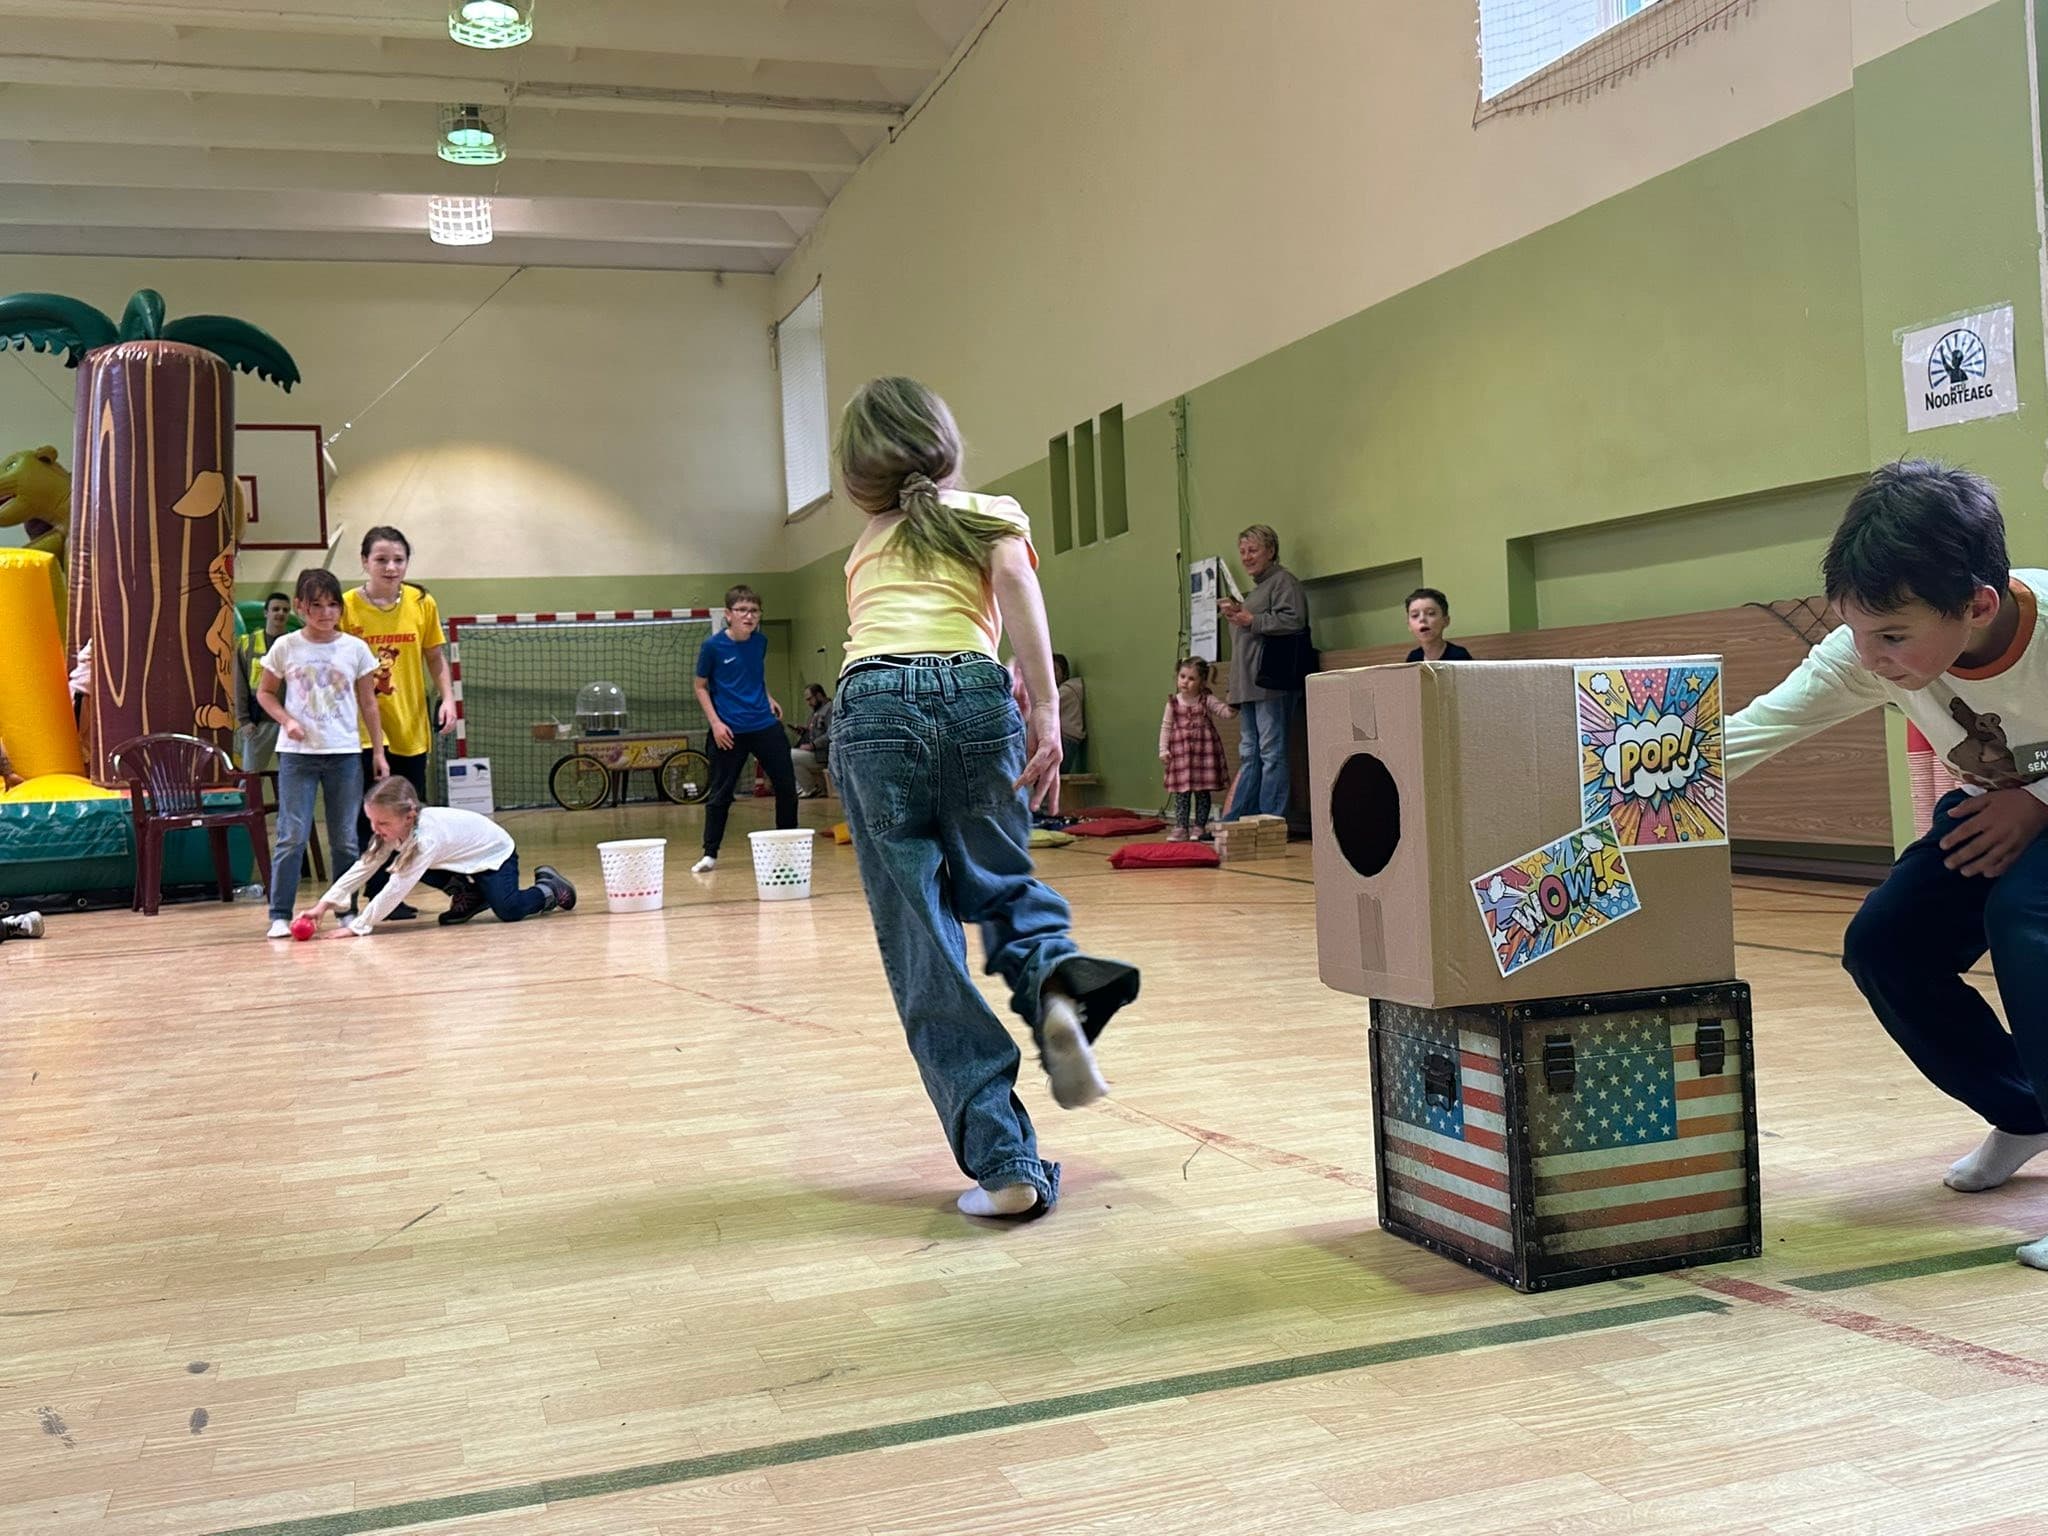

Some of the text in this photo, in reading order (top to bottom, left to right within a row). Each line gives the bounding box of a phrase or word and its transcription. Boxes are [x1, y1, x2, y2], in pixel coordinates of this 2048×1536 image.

[1925, 384, 1993, 411] NOORTEAEG
[1619, 724, 1694, 788] POP!
[1511, 850, 1608, 937] WOW!
